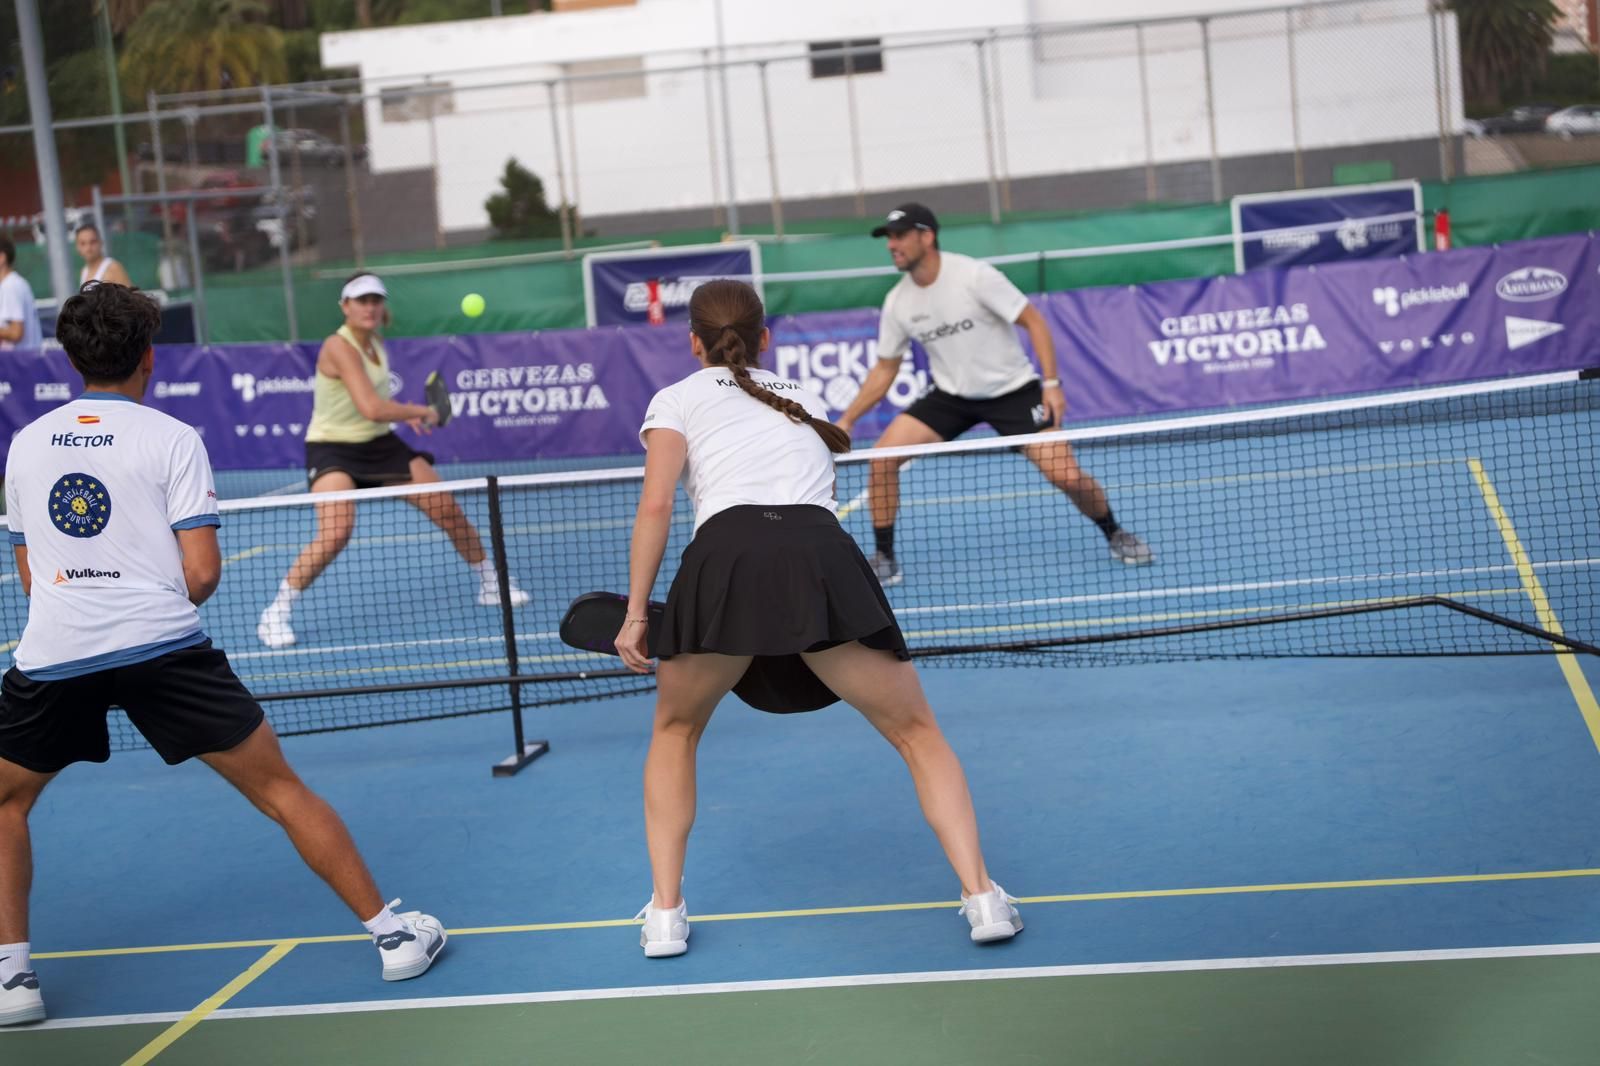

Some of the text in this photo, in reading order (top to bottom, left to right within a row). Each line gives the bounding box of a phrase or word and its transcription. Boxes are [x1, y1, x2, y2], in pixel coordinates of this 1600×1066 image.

[1160, 303, 1310, 338] CERVEZAS
[1147, 324, 1328, 366] VICTORIA
[1378, 331, 1475, 354] VOLVO
[456, 363, 597, 390] CERVEZAS
[449, 384, 611, 417] VICTORIA
[51, 432, 115, 448] HÉCTOR
[65, 568, 121, 580] Vulkano
